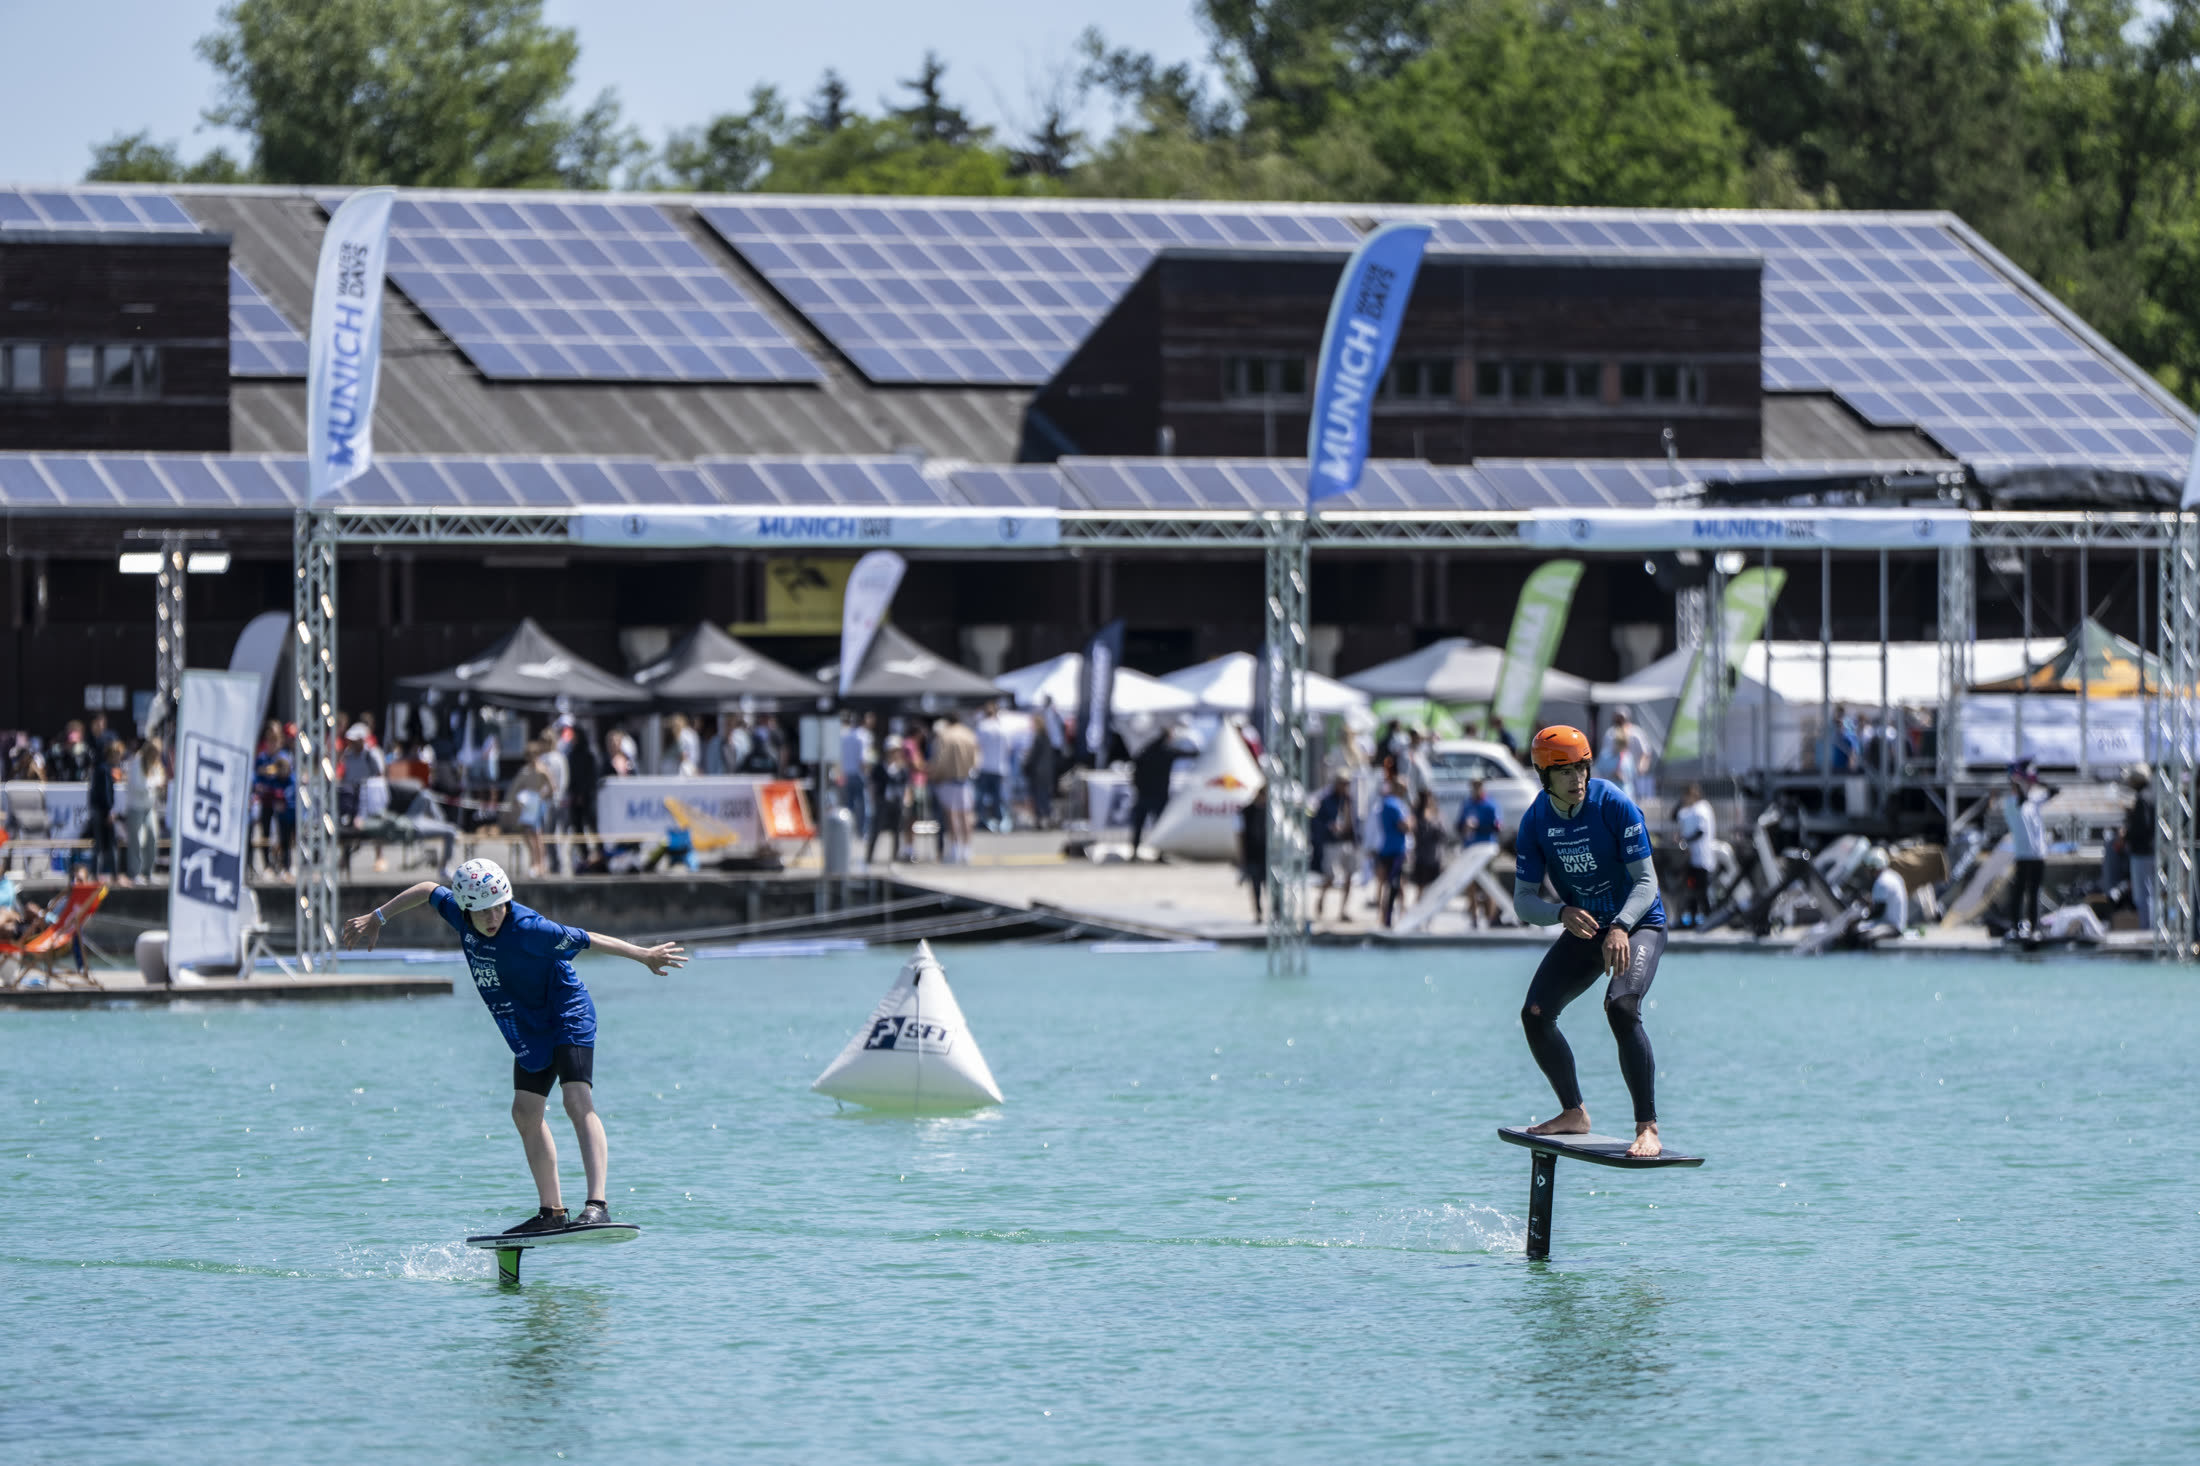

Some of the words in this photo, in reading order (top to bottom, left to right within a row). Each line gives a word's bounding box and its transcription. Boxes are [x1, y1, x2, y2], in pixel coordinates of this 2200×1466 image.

[349, 243, 369, 299] DAYS
[326, 302, 364, 468] MUNICH
[1319, 317, 1381, 484] MUNICH
[758, 516, 857, 538] MUNICH
[1693, 519, 1781, 539] MUNICH
[1556, 844, 1590, 856] MUNICH
[1558, 852, 1595, 864] WATER
[1563, 860, 1598, 873] DAYS
[476, 976, 501, 988] AYS
